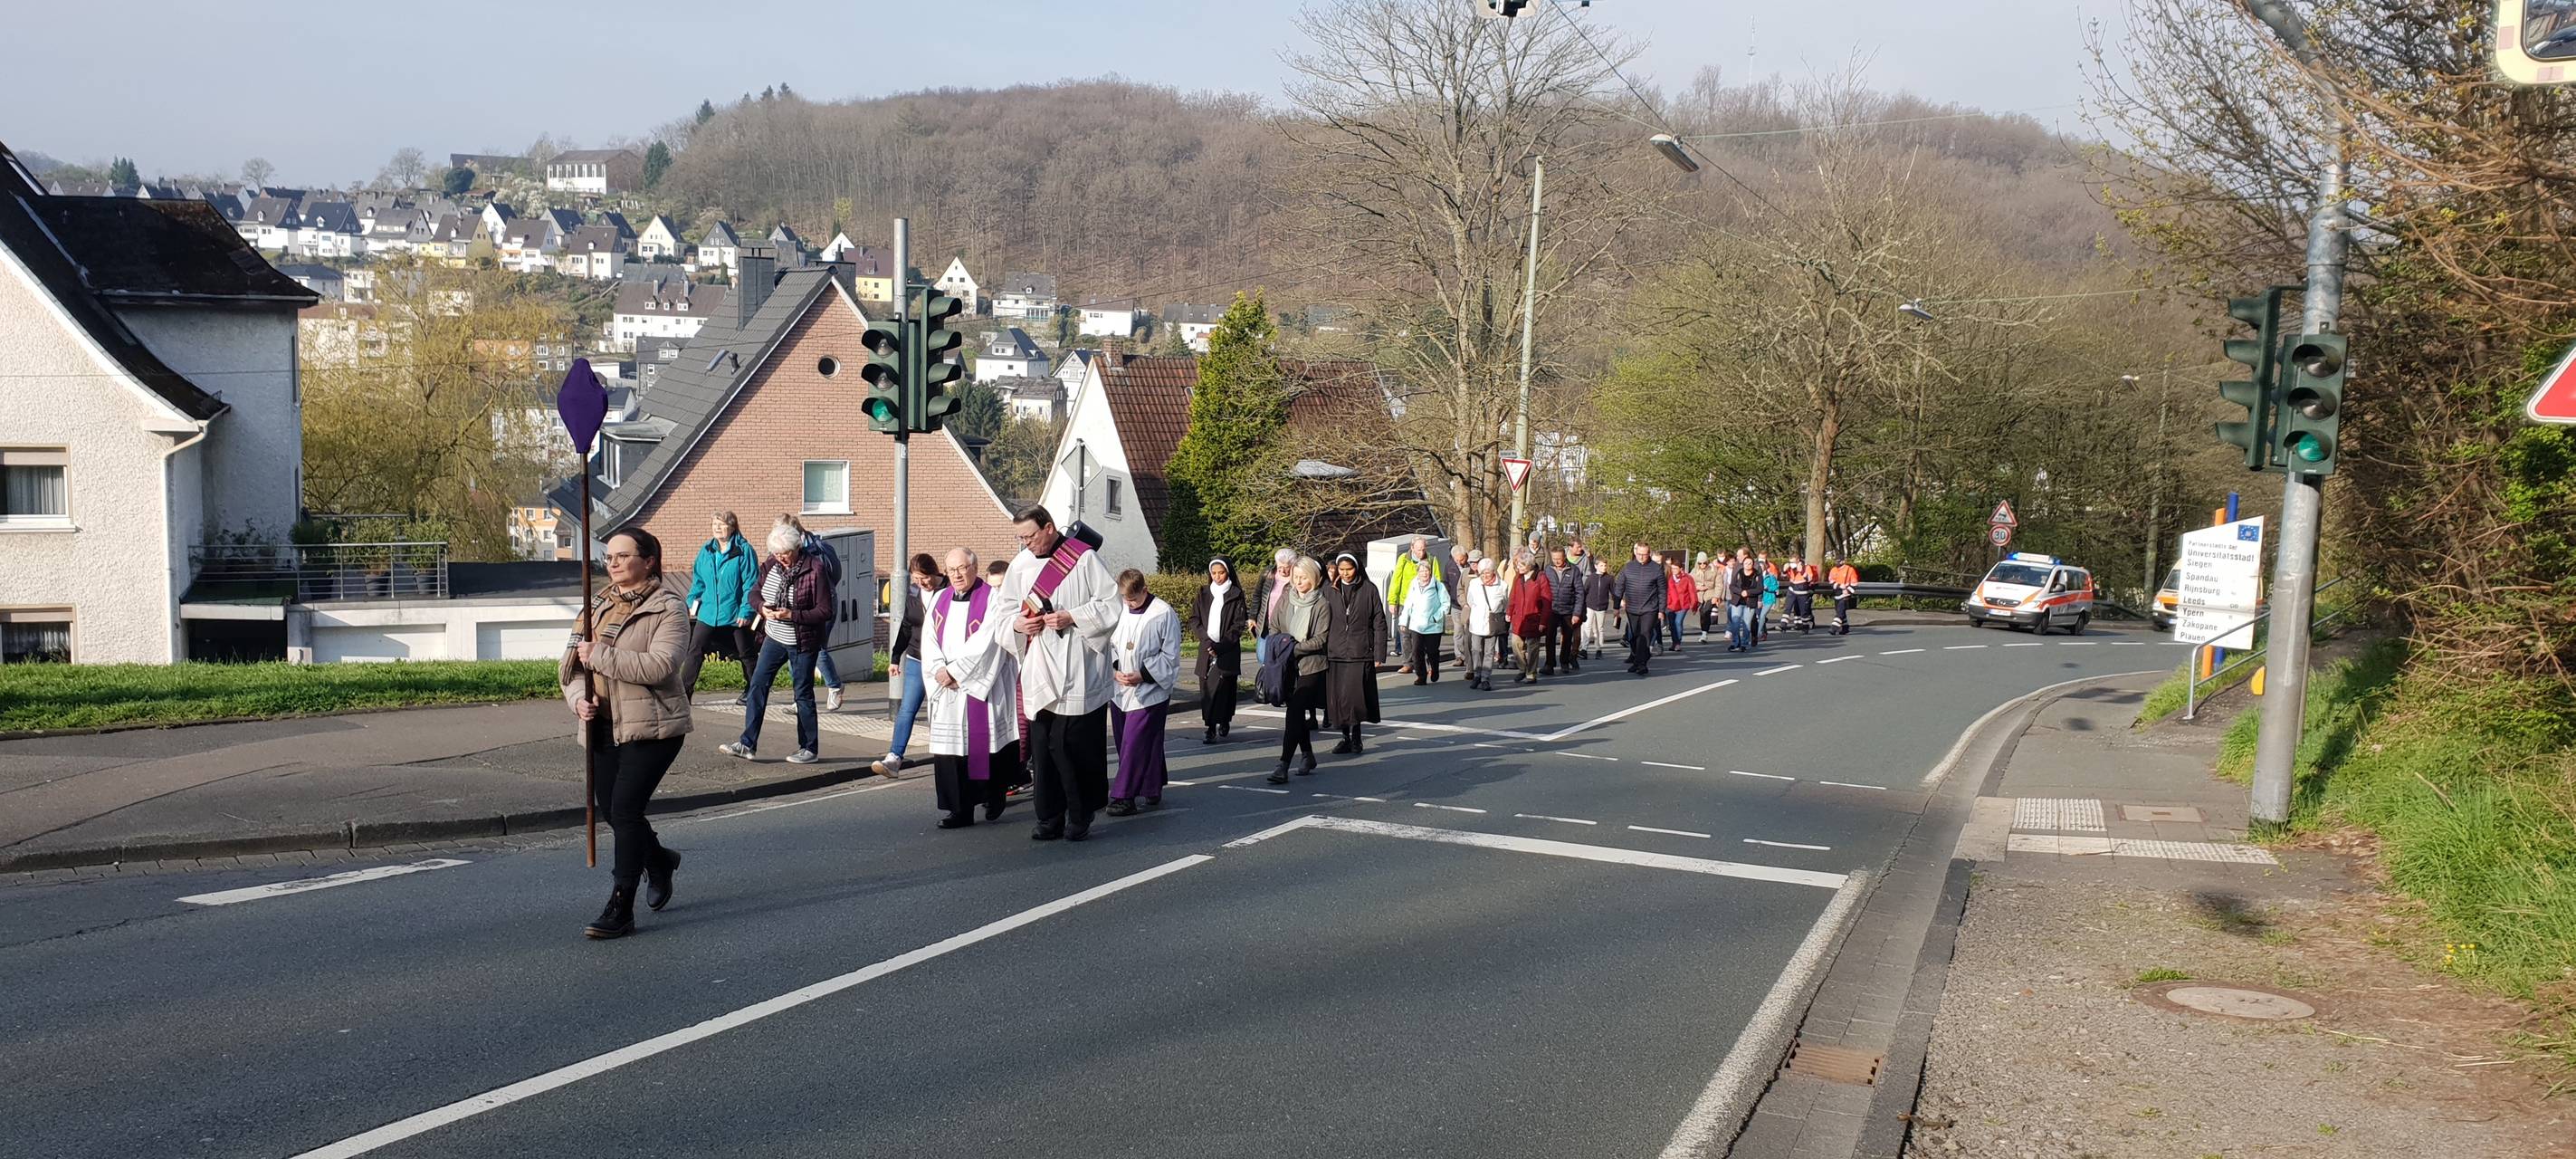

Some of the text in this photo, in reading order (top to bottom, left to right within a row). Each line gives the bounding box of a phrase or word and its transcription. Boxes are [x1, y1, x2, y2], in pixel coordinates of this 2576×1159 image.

[1994, 531, 2006, 540] 30
[2187, 559, 2212, 569] Siegen
[2186, 571, 2218, 582] Spandau
[2184, 584, 2220, 596] Rijnsburg
[2183, 596, 2206, 606] Leeds
[2182, 608, 2204, 617] Ypern
[2182, 619, 2218, 631] Zakopane
[2180, 631, 2206, 642] Plauen
